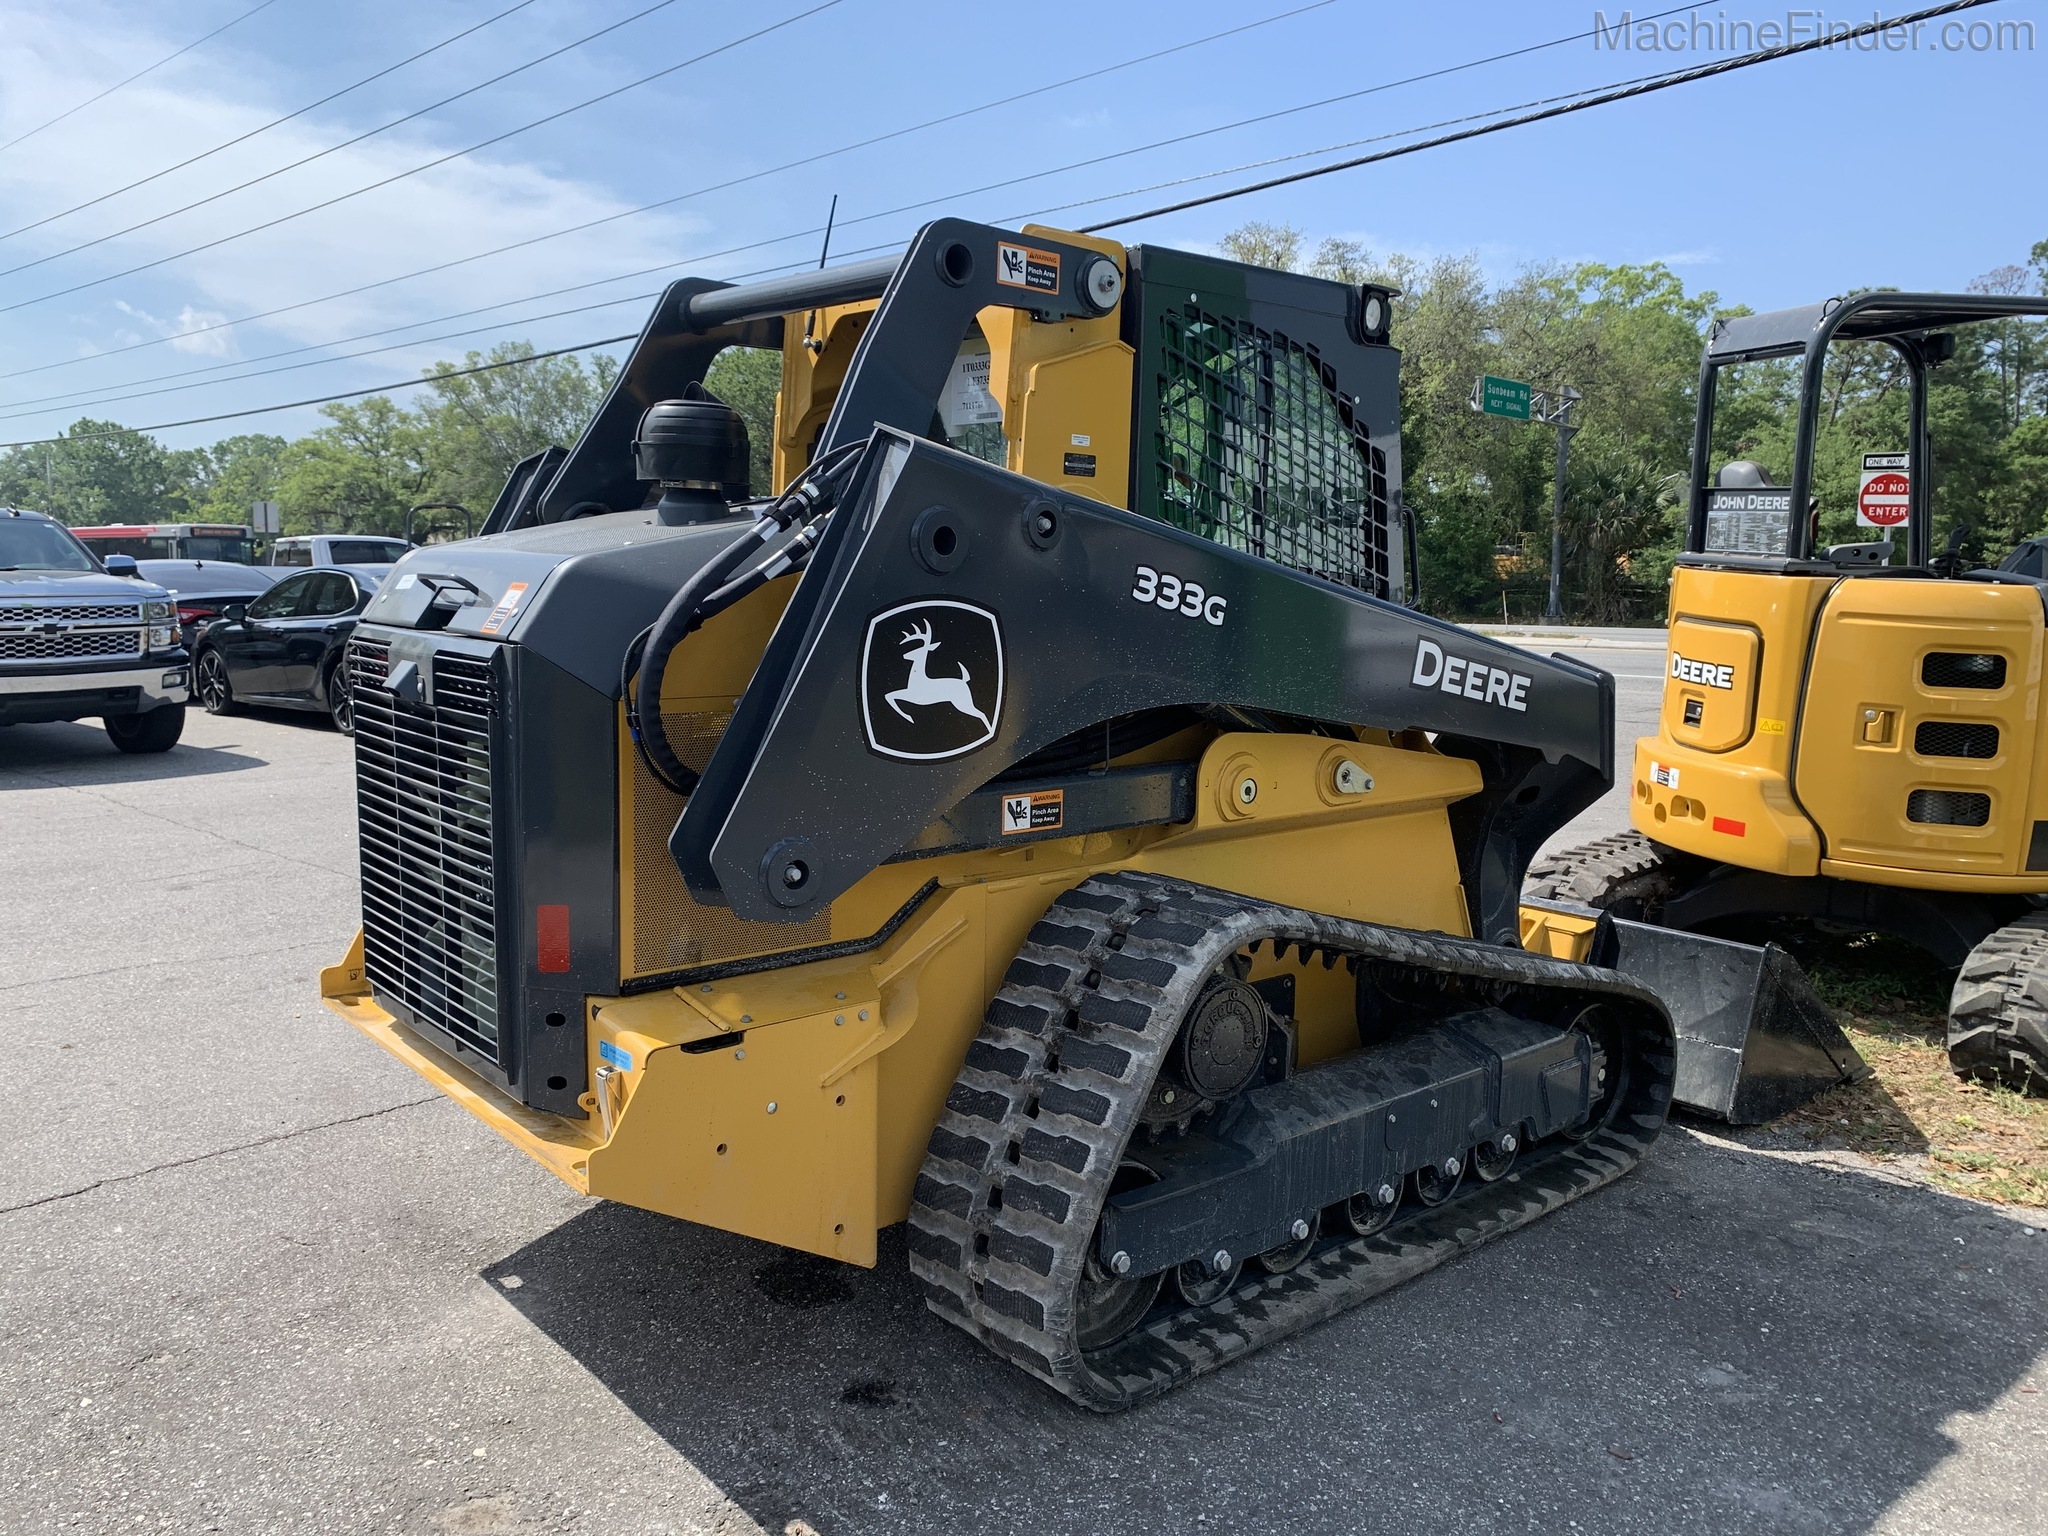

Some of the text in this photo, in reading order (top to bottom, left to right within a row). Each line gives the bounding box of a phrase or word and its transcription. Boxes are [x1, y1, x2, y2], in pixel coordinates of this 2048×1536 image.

[1034, 254, 1057, 264] WARNING
[1028, 267, 1055, 278] Pinch Area
[1028, 276, 1051, 287] Keep Away
[1488, 384, 1528, 400] Sunbeam Rd
[1491, 399, 1522, 412] NEXT SIGNAL
[1869, 483, 1884, 493] DO
[1713, 494, 1791, 510] JOHN DEERE
[1868, 507, 1907, 516] ENTER
[1132, 566, 1227, 626] 333G
[1412, 639, 1532, 712] DEERE
[1671, 652, 1734, 690] DEERE
